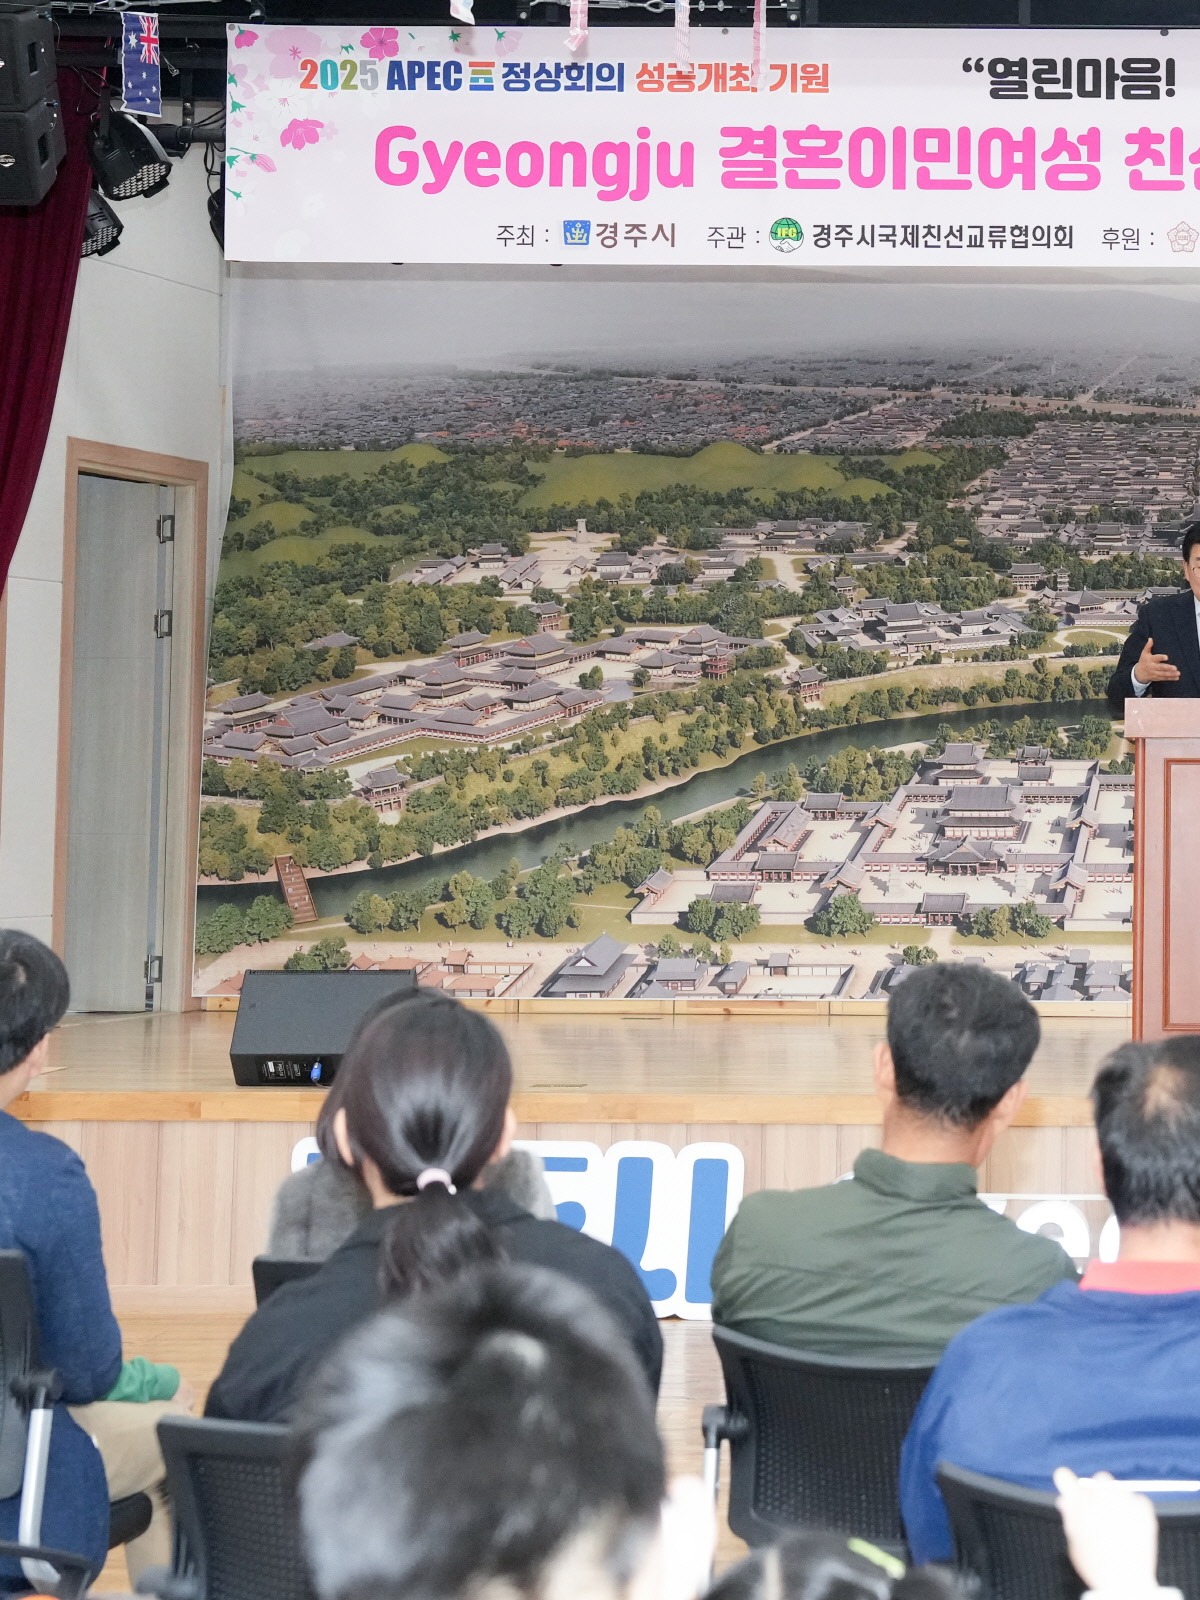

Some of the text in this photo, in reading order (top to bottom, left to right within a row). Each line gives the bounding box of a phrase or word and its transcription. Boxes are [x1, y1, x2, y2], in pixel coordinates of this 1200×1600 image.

[299, 59, 830, 94] 2025 APEC 정상회의 성공개최 기원
[374, 124, 695, 203] Gyeongju
[718, 124, 1102, 192] 결혼이민여성
[595, 222, 676, 249] 경주시
[812, 223, 1074, 250] 경주시국제친선교류협의회
